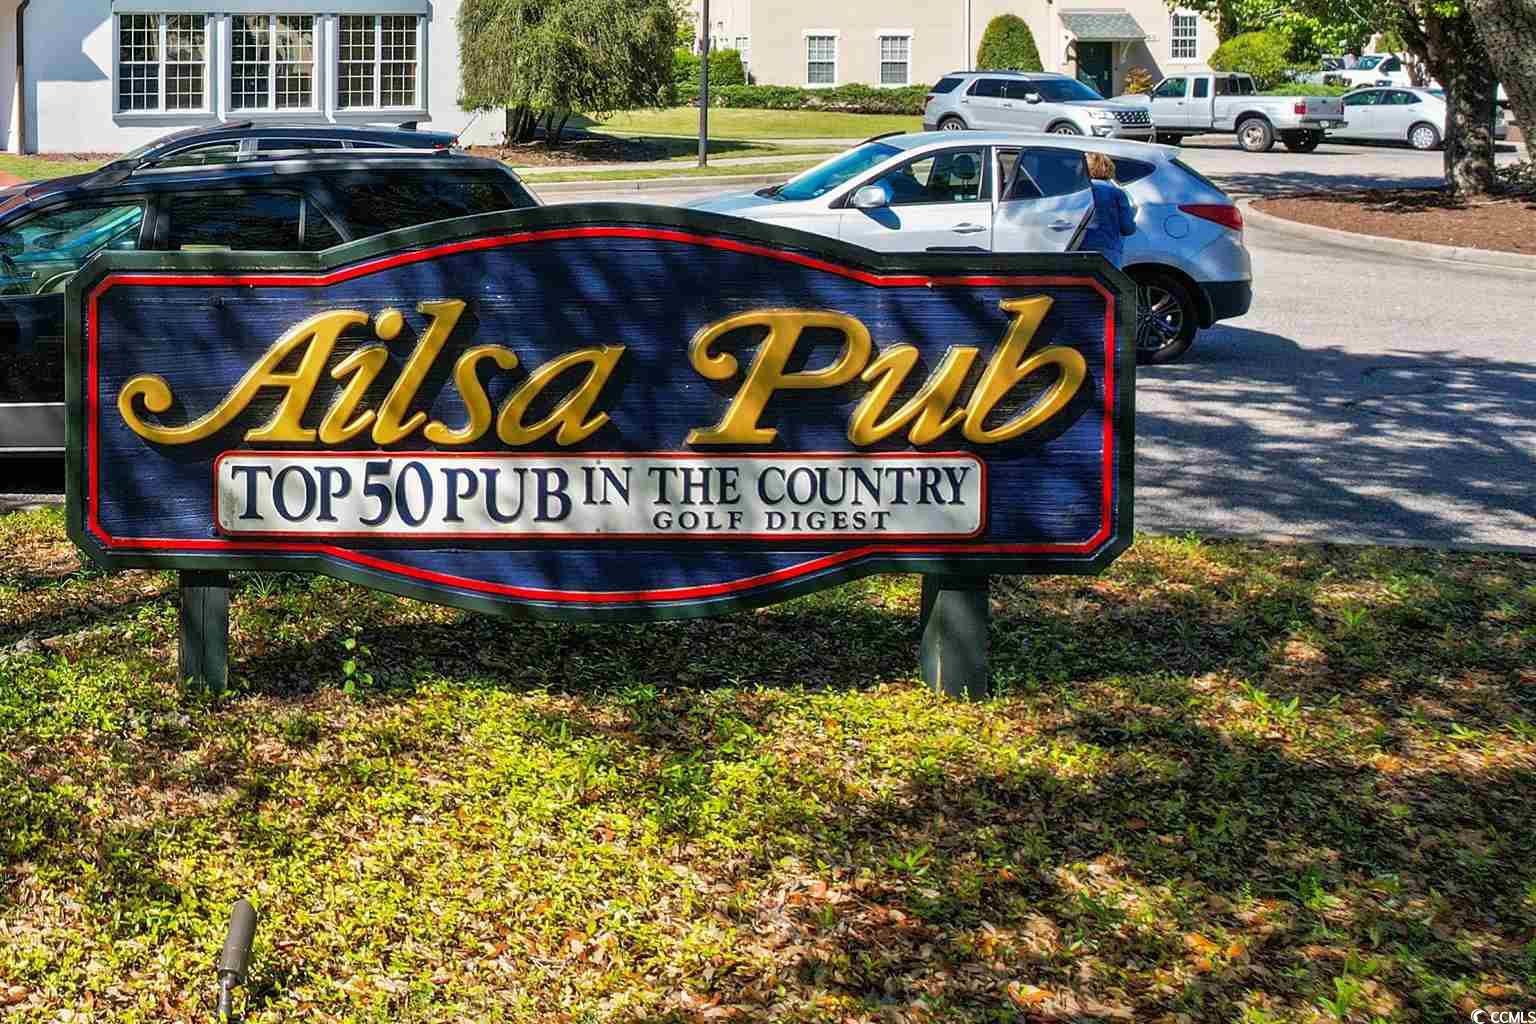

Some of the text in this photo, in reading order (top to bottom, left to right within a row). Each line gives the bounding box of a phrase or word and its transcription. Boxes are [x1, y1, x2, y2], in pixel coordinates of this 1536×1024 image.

[117, 294, 1087, 446] Ailsa Pub
[230, 459, 971, 528] TOP 50 PUB IN THE COUNTRY
[652, 510, 893, 531] GOLF DIGEST
